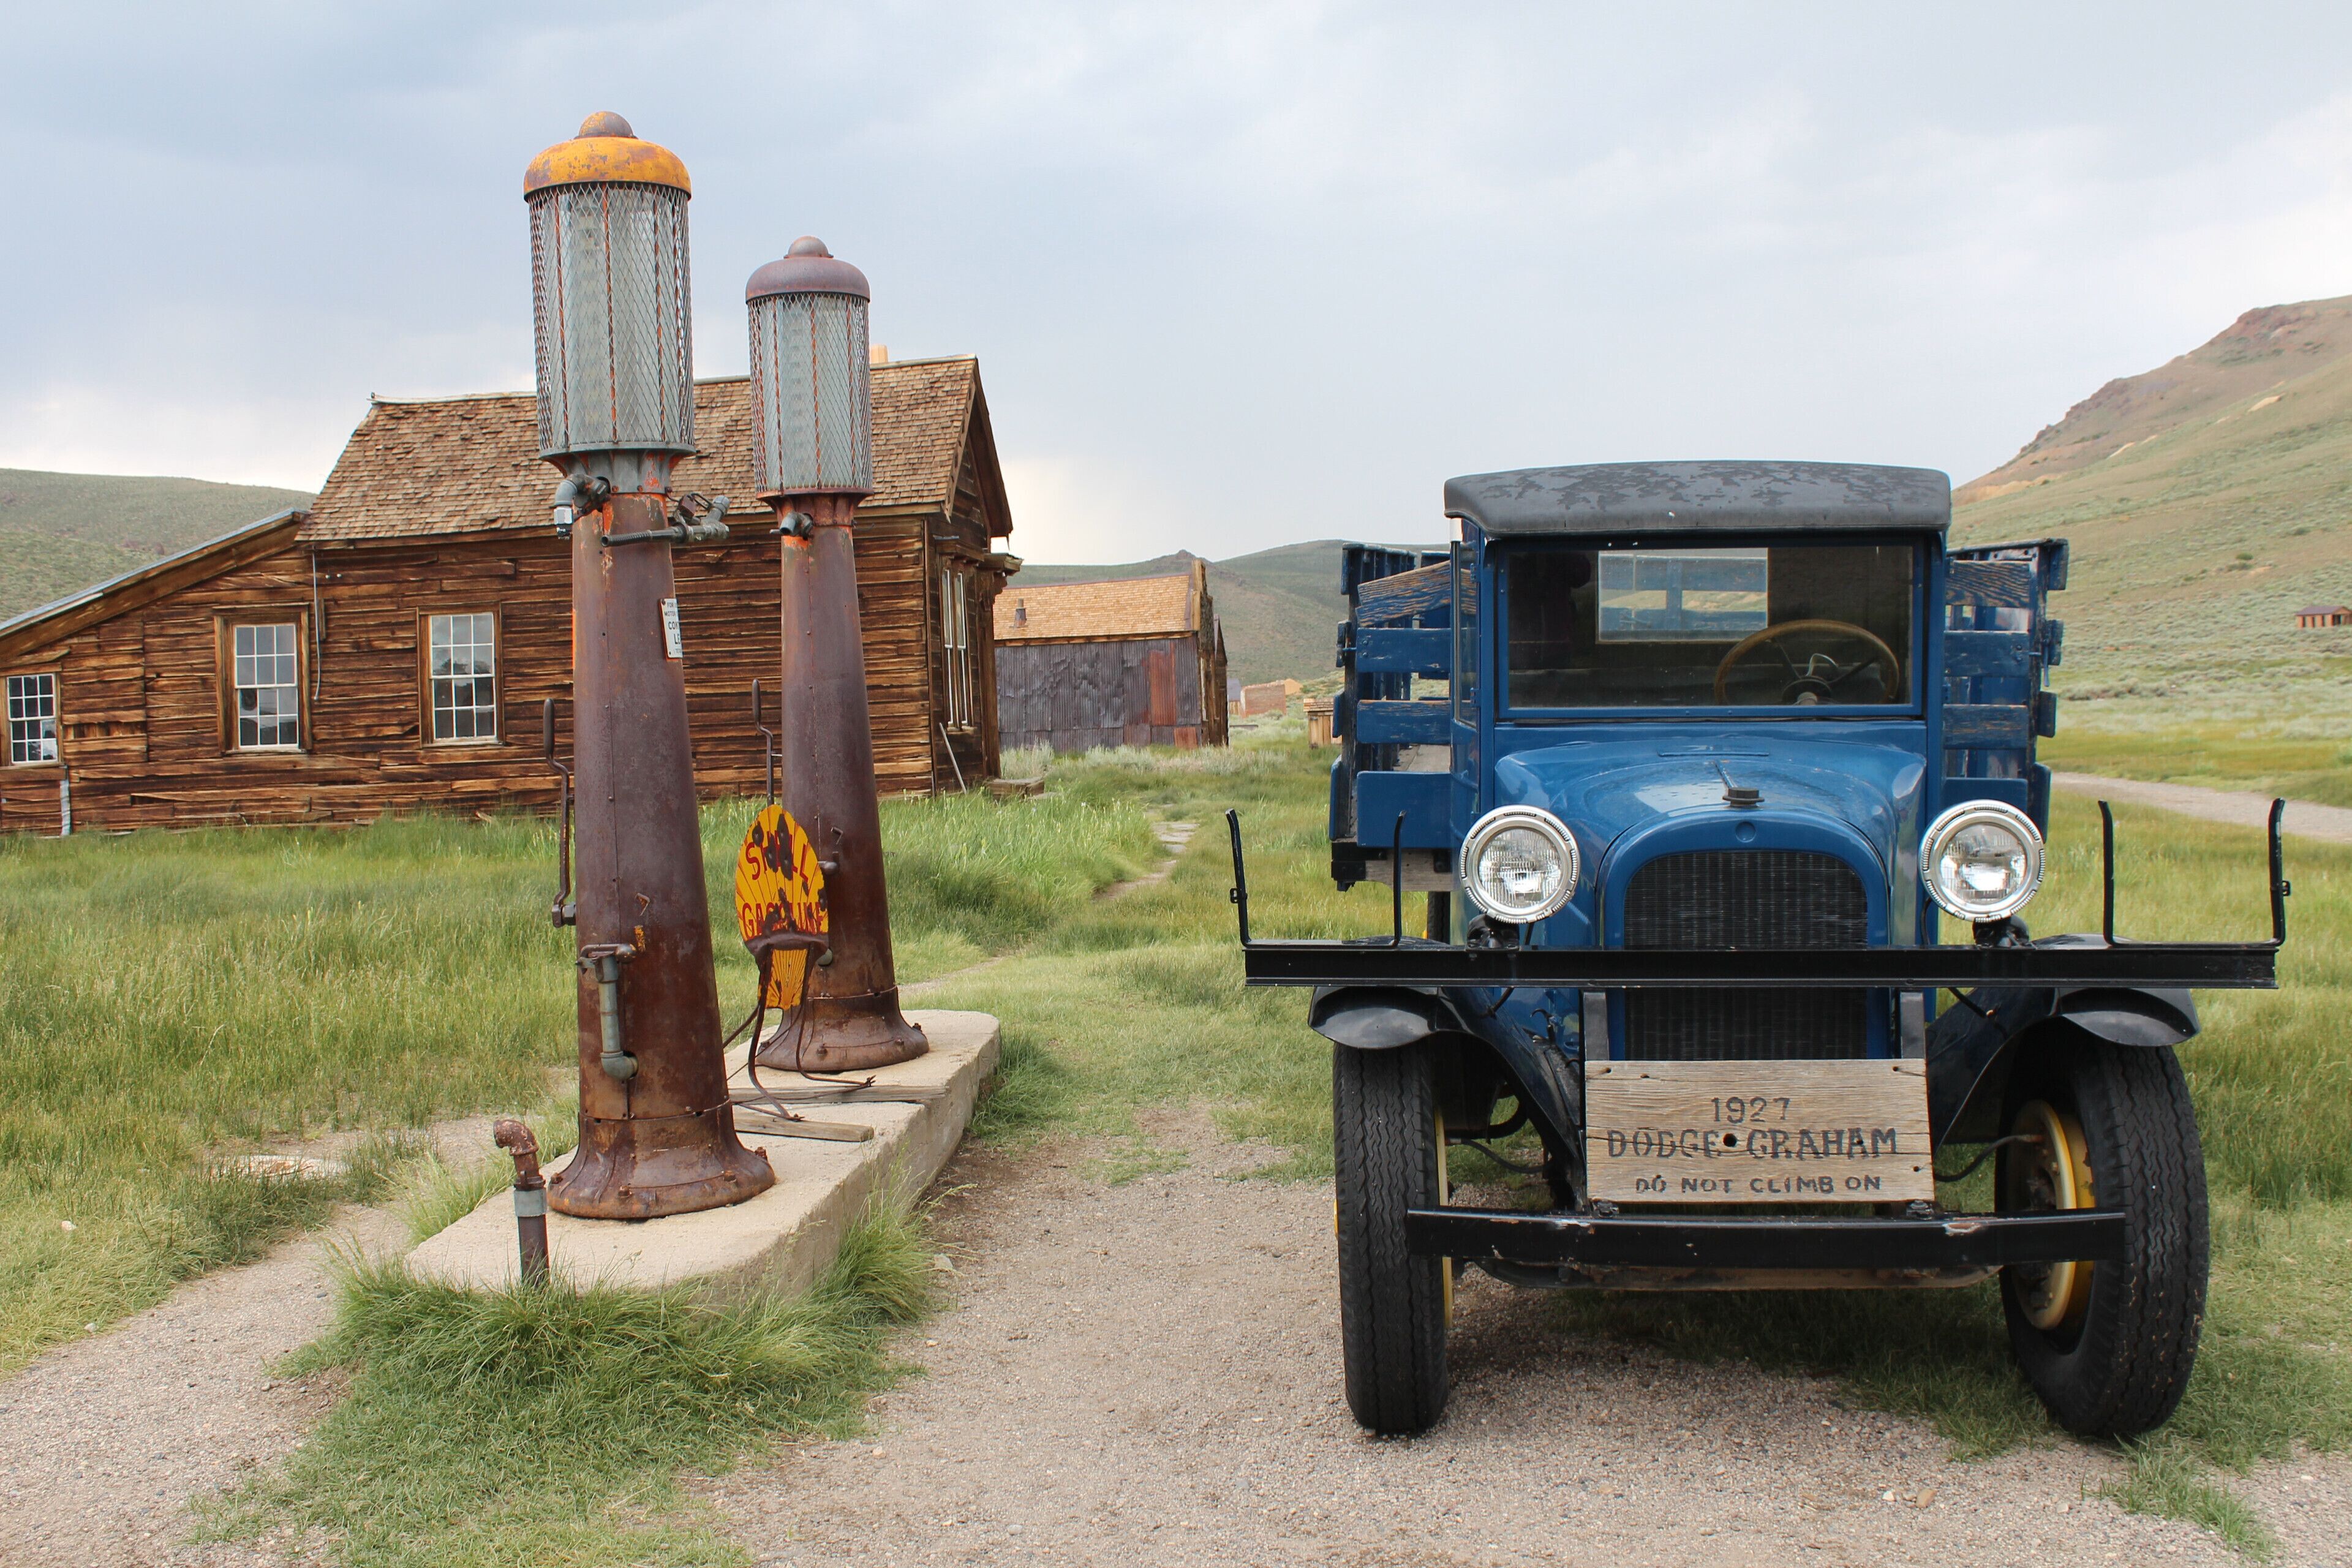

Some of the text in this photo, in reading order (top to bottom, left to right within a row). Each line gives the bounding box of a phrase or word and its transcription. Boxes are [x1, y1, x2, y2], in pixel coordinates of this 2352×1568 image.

[1711, 1096, 1790, 1124] 1927
[1607, 1128, 1897, 1161] DODGE GRAHAM
[1635, 1174, 1880, 1194] DO NOT CLIMB ON
